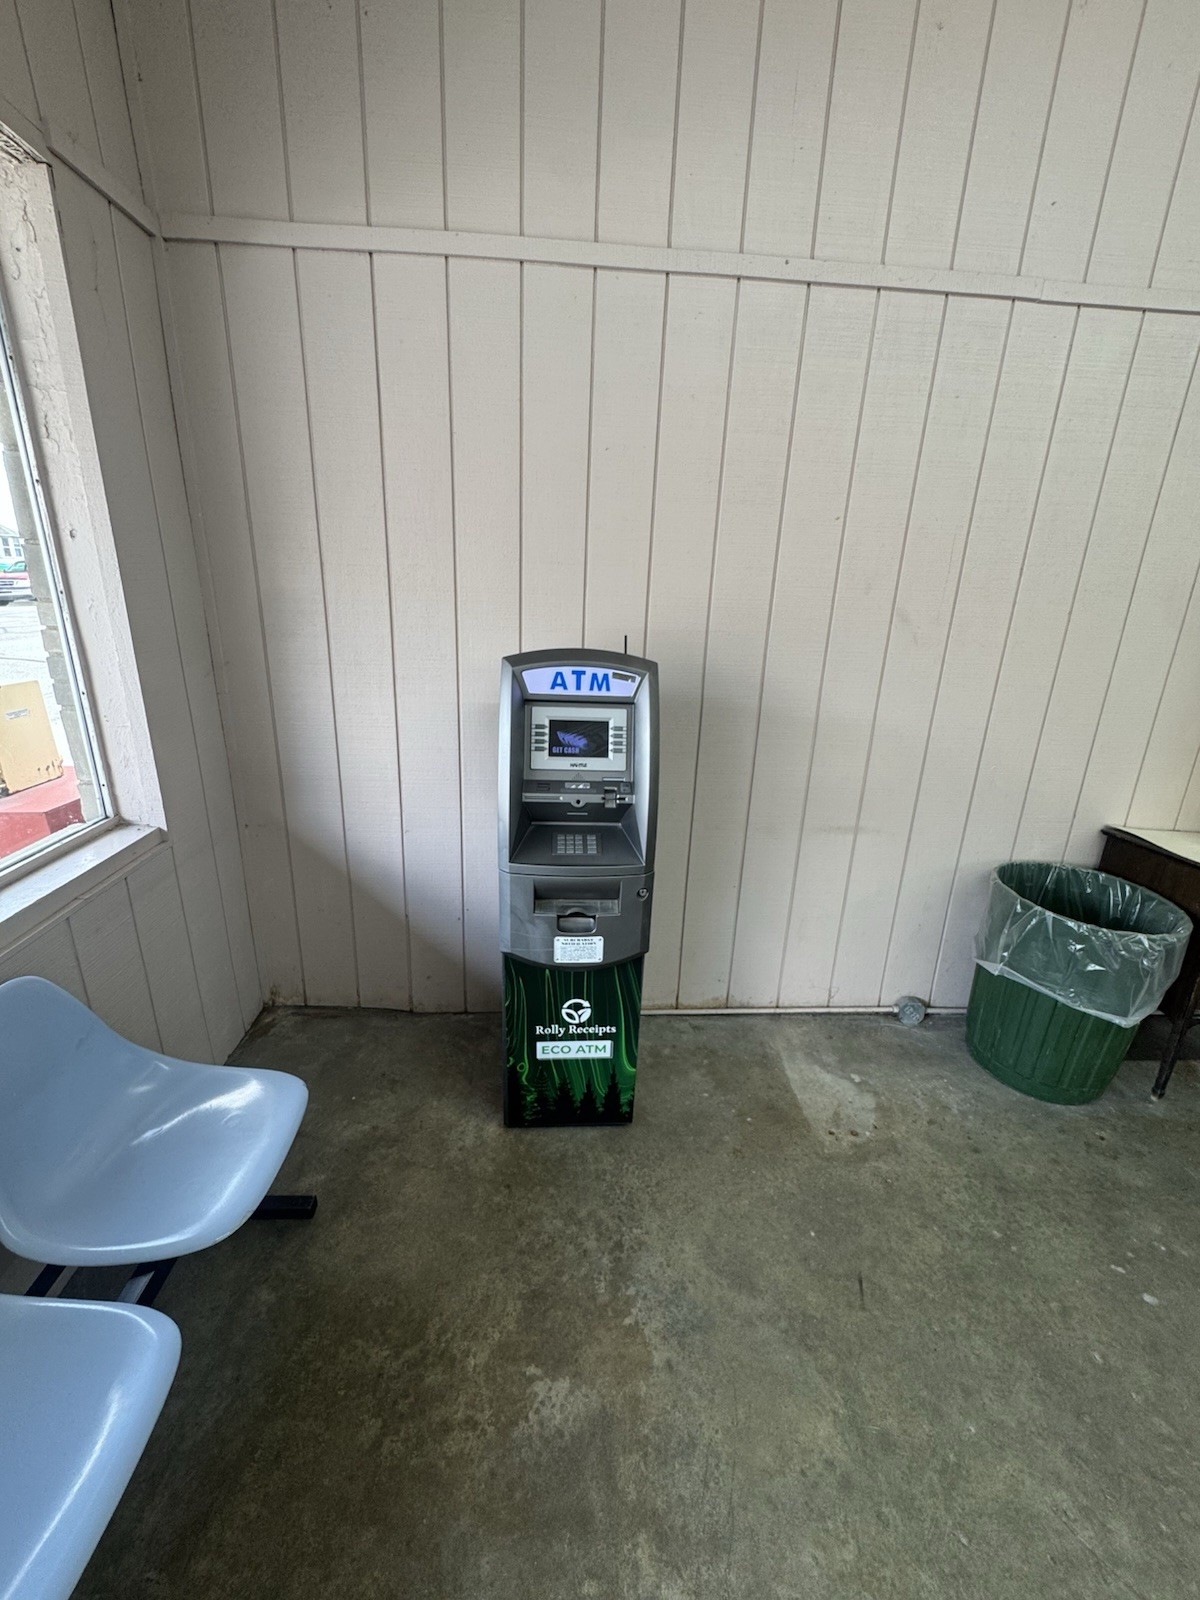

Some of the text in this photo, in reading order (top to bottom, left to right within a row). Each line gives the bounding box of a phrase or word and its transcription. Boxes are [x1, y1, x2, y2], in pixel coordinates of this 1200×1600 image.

[550, 670, 611, 692] ATM
[564, 746, 580, 754] CASH
[535, 1024, 617, 1037] Rolly Receipts
[541, 1044, 607, 1054] ECO ATM
